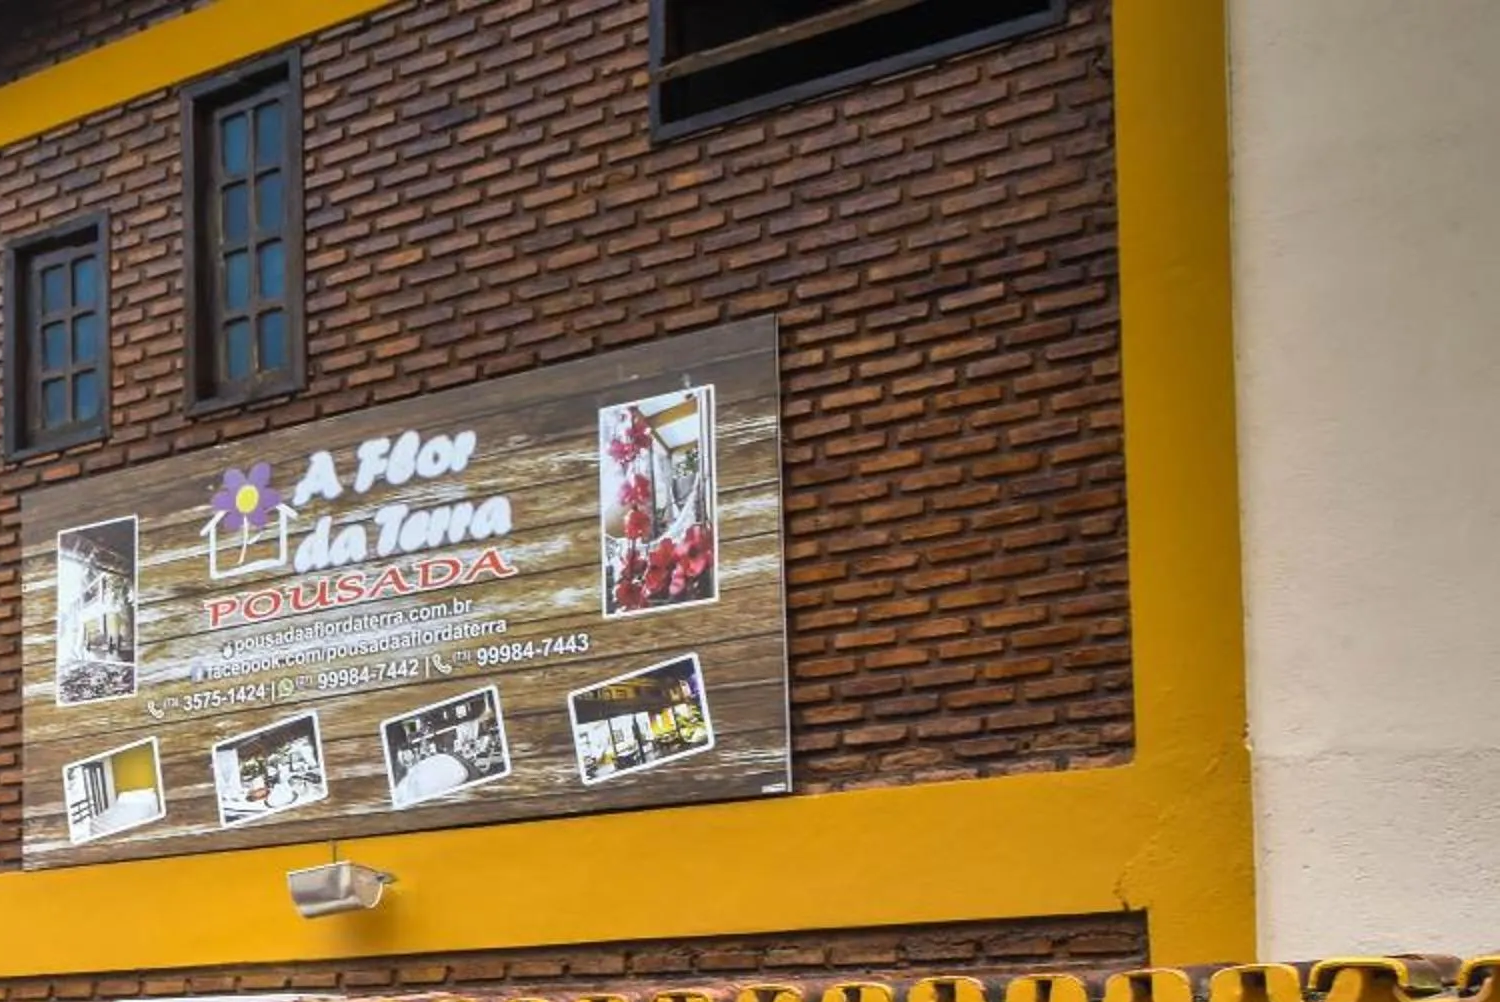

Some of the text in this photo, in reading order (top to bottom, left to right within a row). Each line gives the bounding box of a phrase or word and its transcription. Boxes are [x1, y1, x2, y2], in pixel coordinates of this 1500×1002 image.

[292, 430, 477, 506] A Flor
[294, 496, 512, 574] da Terra
[204, 546, 518, 629] POUSADA
[235, 598, 472, 653] pousadaaflordaterra.com.br
[183, 683, 266, 711] 3575-1424
[317, 658, 419, 690] 99984-7442
[477, 633, 589, 667] 99984-7443
[206, 619, 507, 680] facebook.com/pousadaaflordaterra
